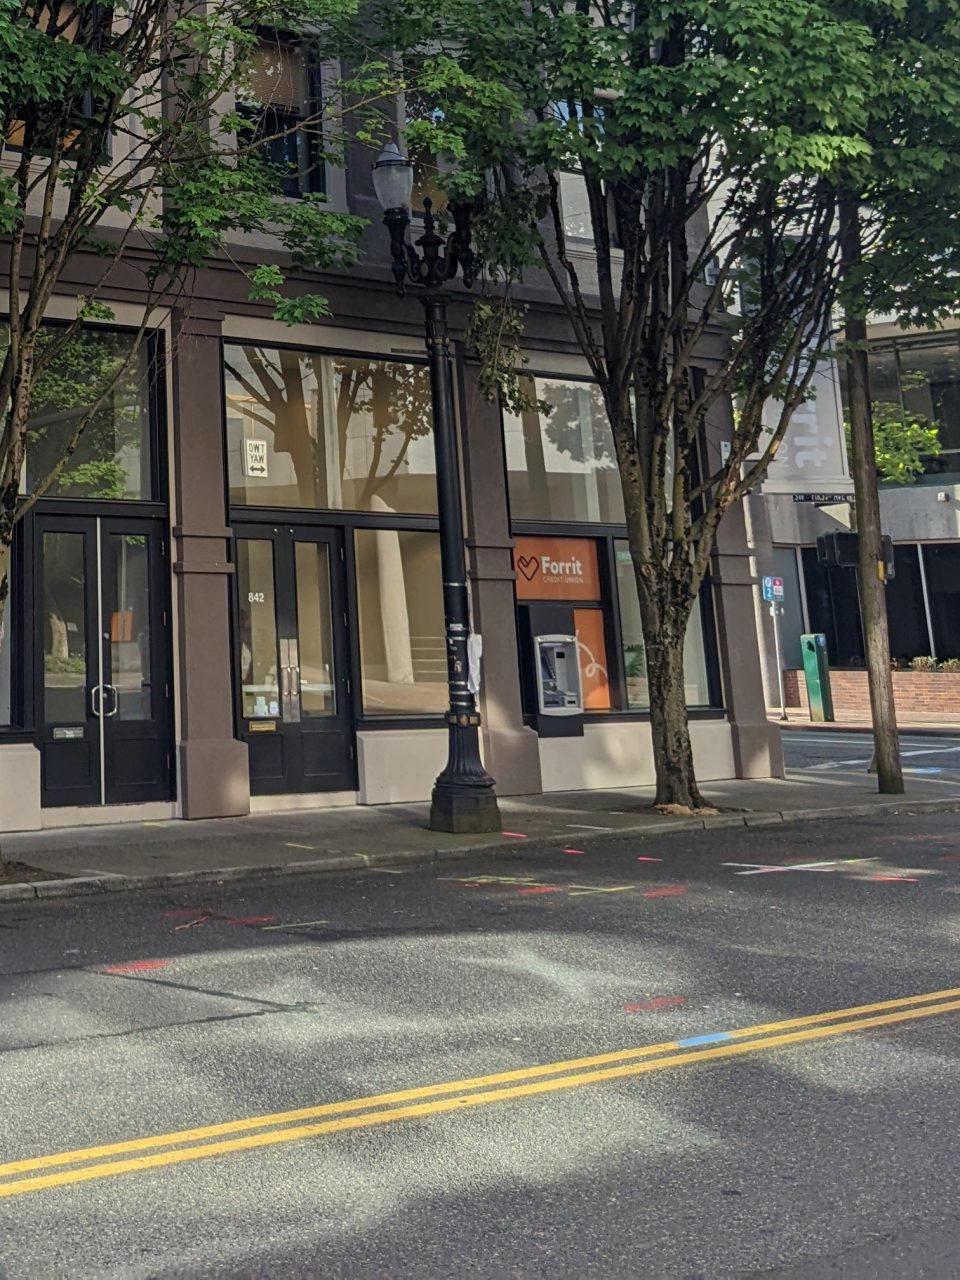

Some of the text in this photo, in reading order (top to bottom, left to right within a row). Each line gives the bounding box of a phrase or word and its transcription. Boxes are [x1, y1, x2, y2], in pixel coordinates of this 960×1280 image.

[541, 556, 583, 575] Forrit
[542, 576, 584, 584] CREDIT UNION
[248, 592, 265, 602] 842
